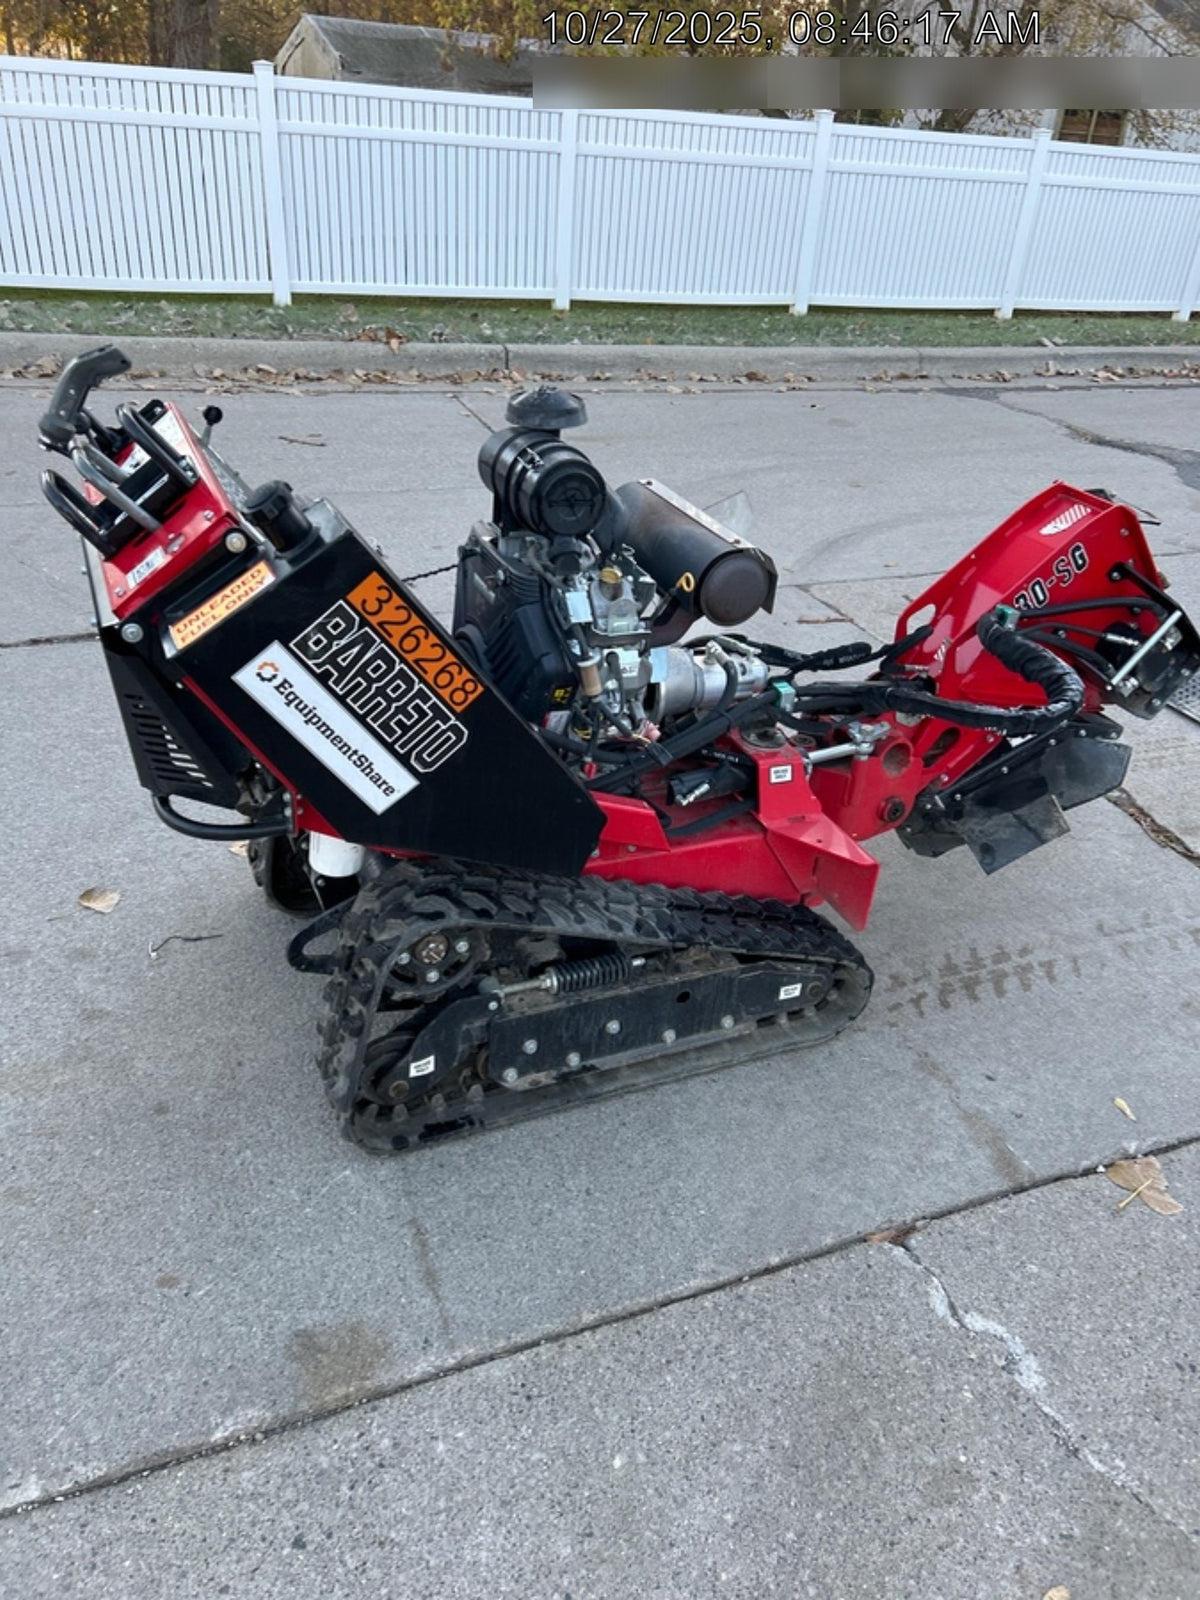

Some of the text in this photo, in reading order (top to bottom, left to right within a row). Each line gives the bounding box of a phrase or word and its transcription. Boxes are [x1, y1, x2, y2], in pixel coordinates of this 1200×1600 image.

[176, 568, 262, 634] UNLEADED
[180, 576, 266, 644] FUEL ONLY
[360, 584, 479, 707] 326268
[273, 677, 397, 798] EquipmentShare
[289, 599, 469, 773] BARRETO
